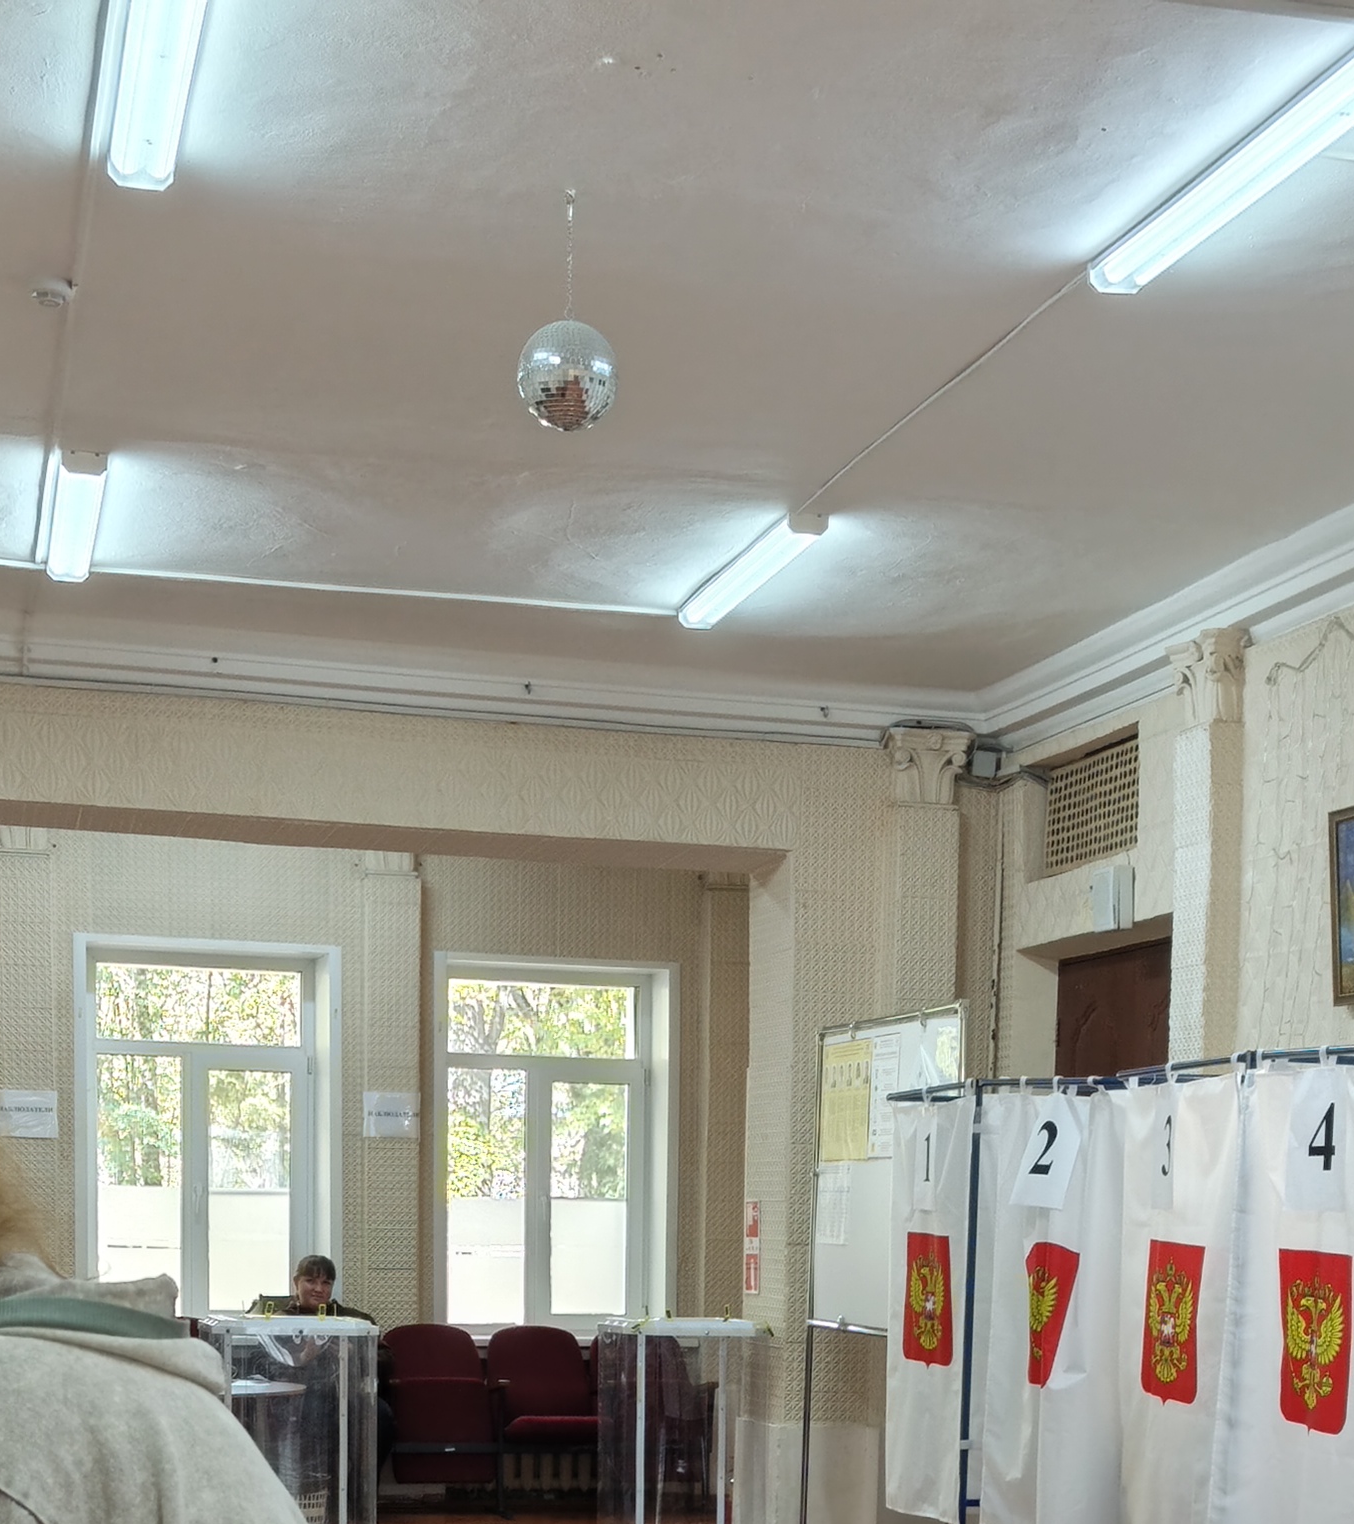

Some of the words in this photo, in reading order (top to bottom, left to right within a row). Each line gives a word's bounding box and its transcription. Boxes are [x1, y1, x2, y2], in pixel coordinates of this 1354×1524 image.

[924, 1133, 931, 1183] 1
[1028, 1120, 1058, 1176] 2
[1161, 1114, 1172, 1177] 3
[1307, 1102, 1336, 1172] 4
